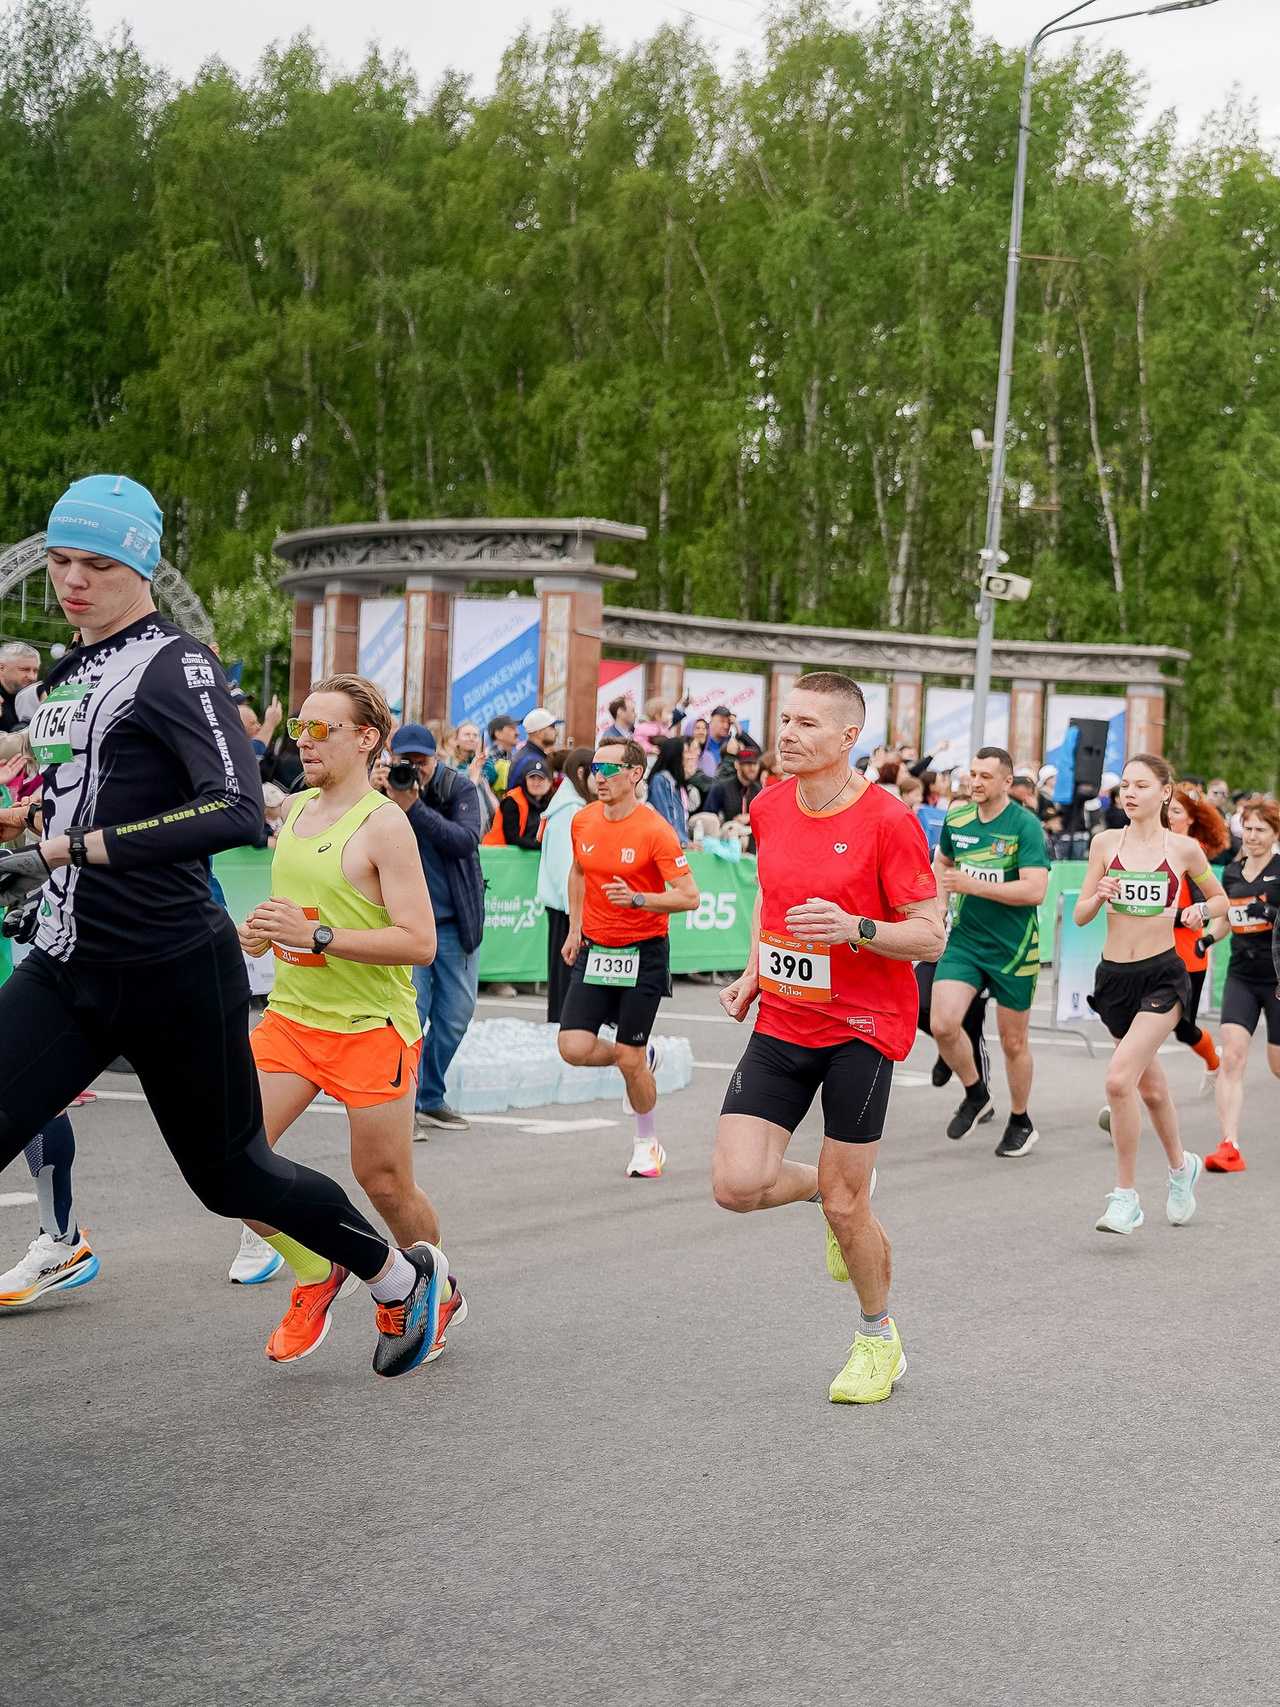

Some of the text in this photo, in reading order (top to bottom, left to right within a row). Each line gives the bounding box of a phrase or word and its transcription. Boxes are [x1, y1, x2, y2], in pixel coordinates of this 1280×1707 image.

[462, 647, 537, 713] ДВИЖЕНИЕ
[35, 705, 72, 739] 1154
[199, 691, 219, 727] TAGIL
[116, 819, 160, 836] HARD
[162, 808, 197, 824] RUN
[620, 847, 636, 864] 10
[484, 894, 521, 912] лёный
[484, 911, 516, 931] афон
[593, 957, 633, 974] 1330
[770, 951, 813, 981] 390
